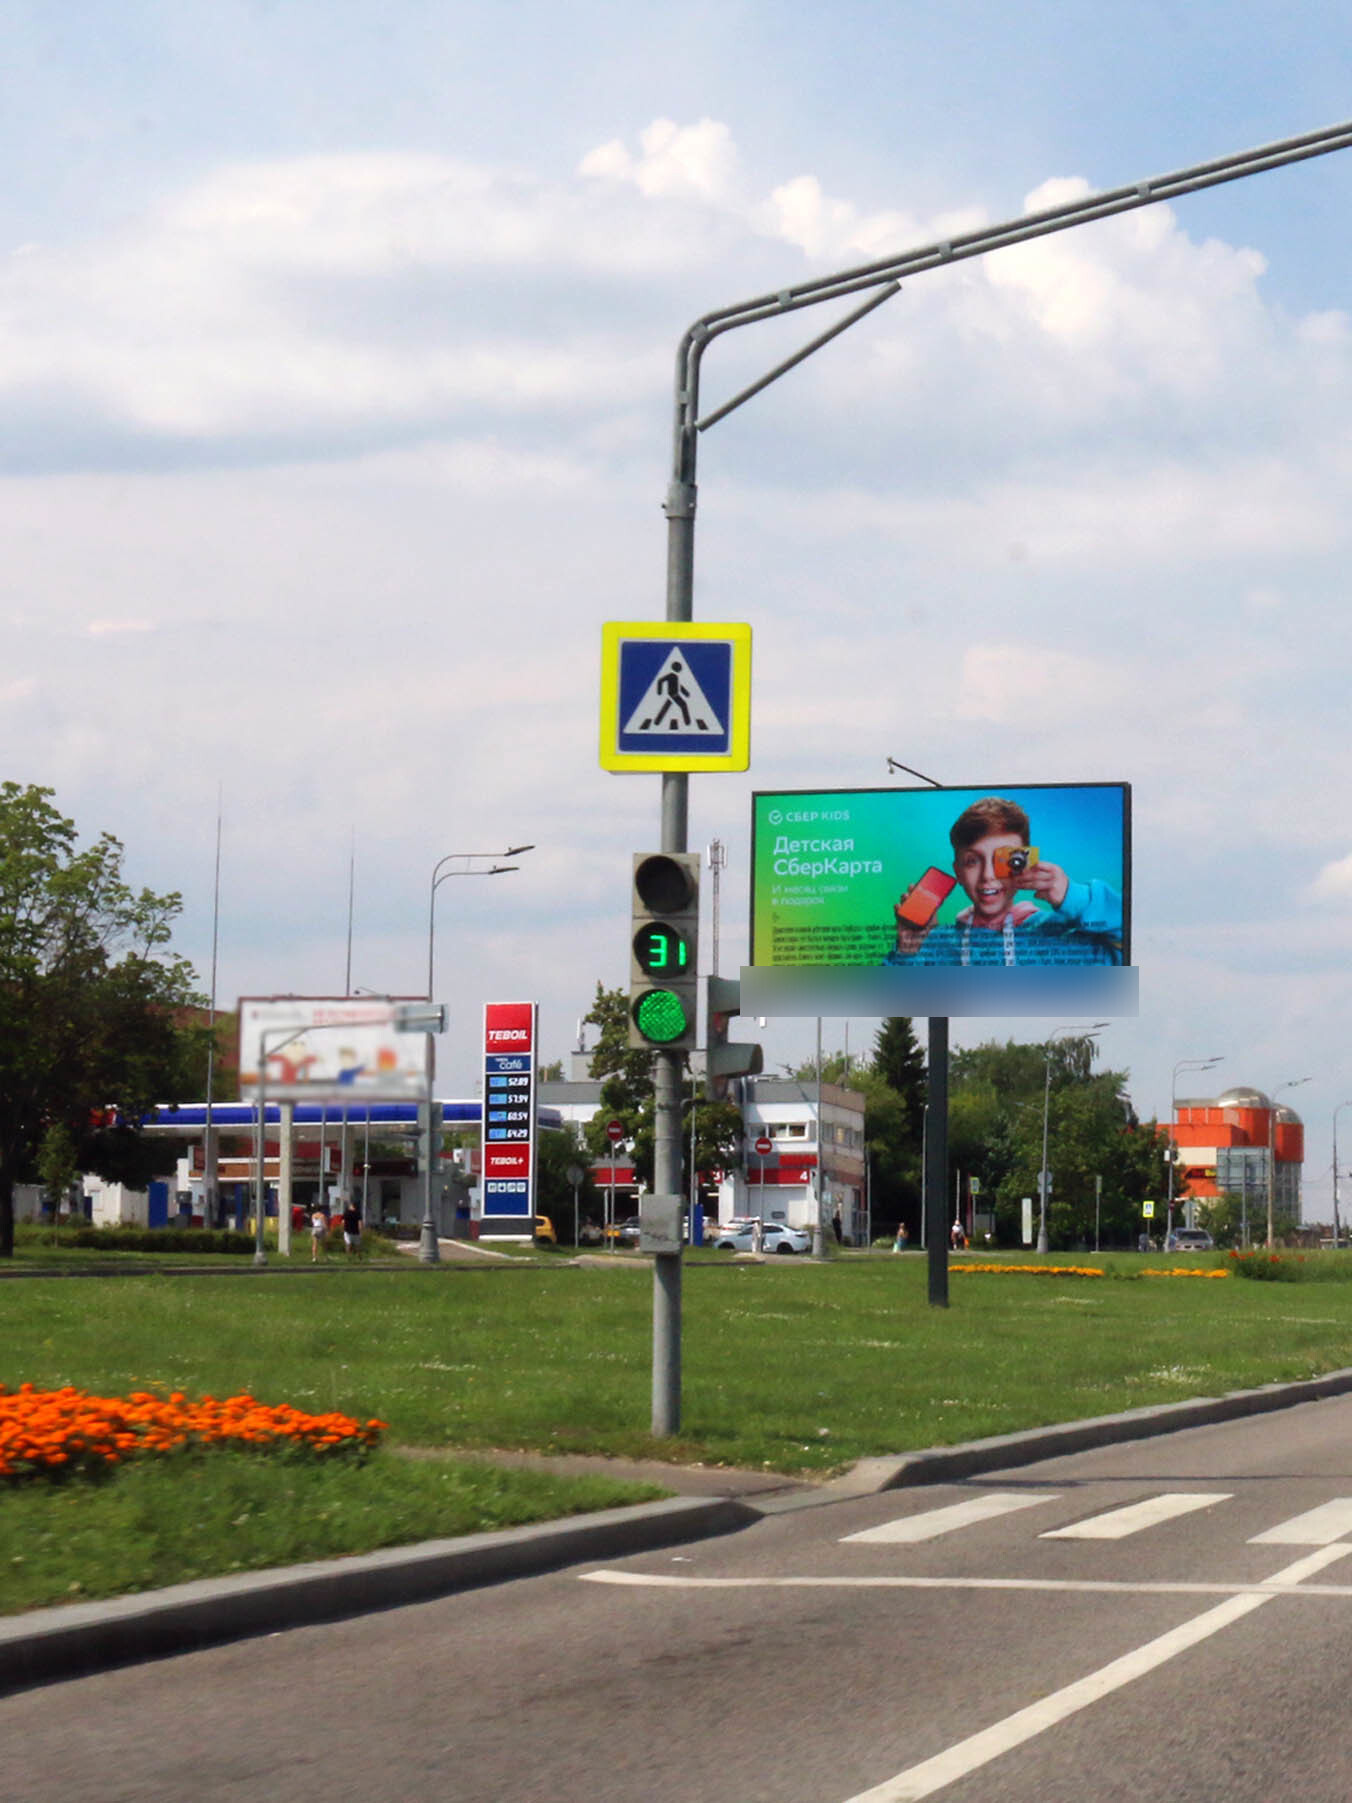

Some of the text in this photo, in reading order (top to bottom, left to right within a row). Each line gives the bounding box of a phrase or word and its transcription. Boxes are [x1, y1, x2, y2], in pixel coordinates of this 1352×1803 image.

[785, 810, 851, 822] СБЕР KIDS
[773, 836, 856, 856] Детская
[773, 857, 884, 879] СберКарта
[649, 934, 687, 968] 31
[488, 1029, 528, 1041] TEBOIL
[800, 1170, 809, 1180] 4
